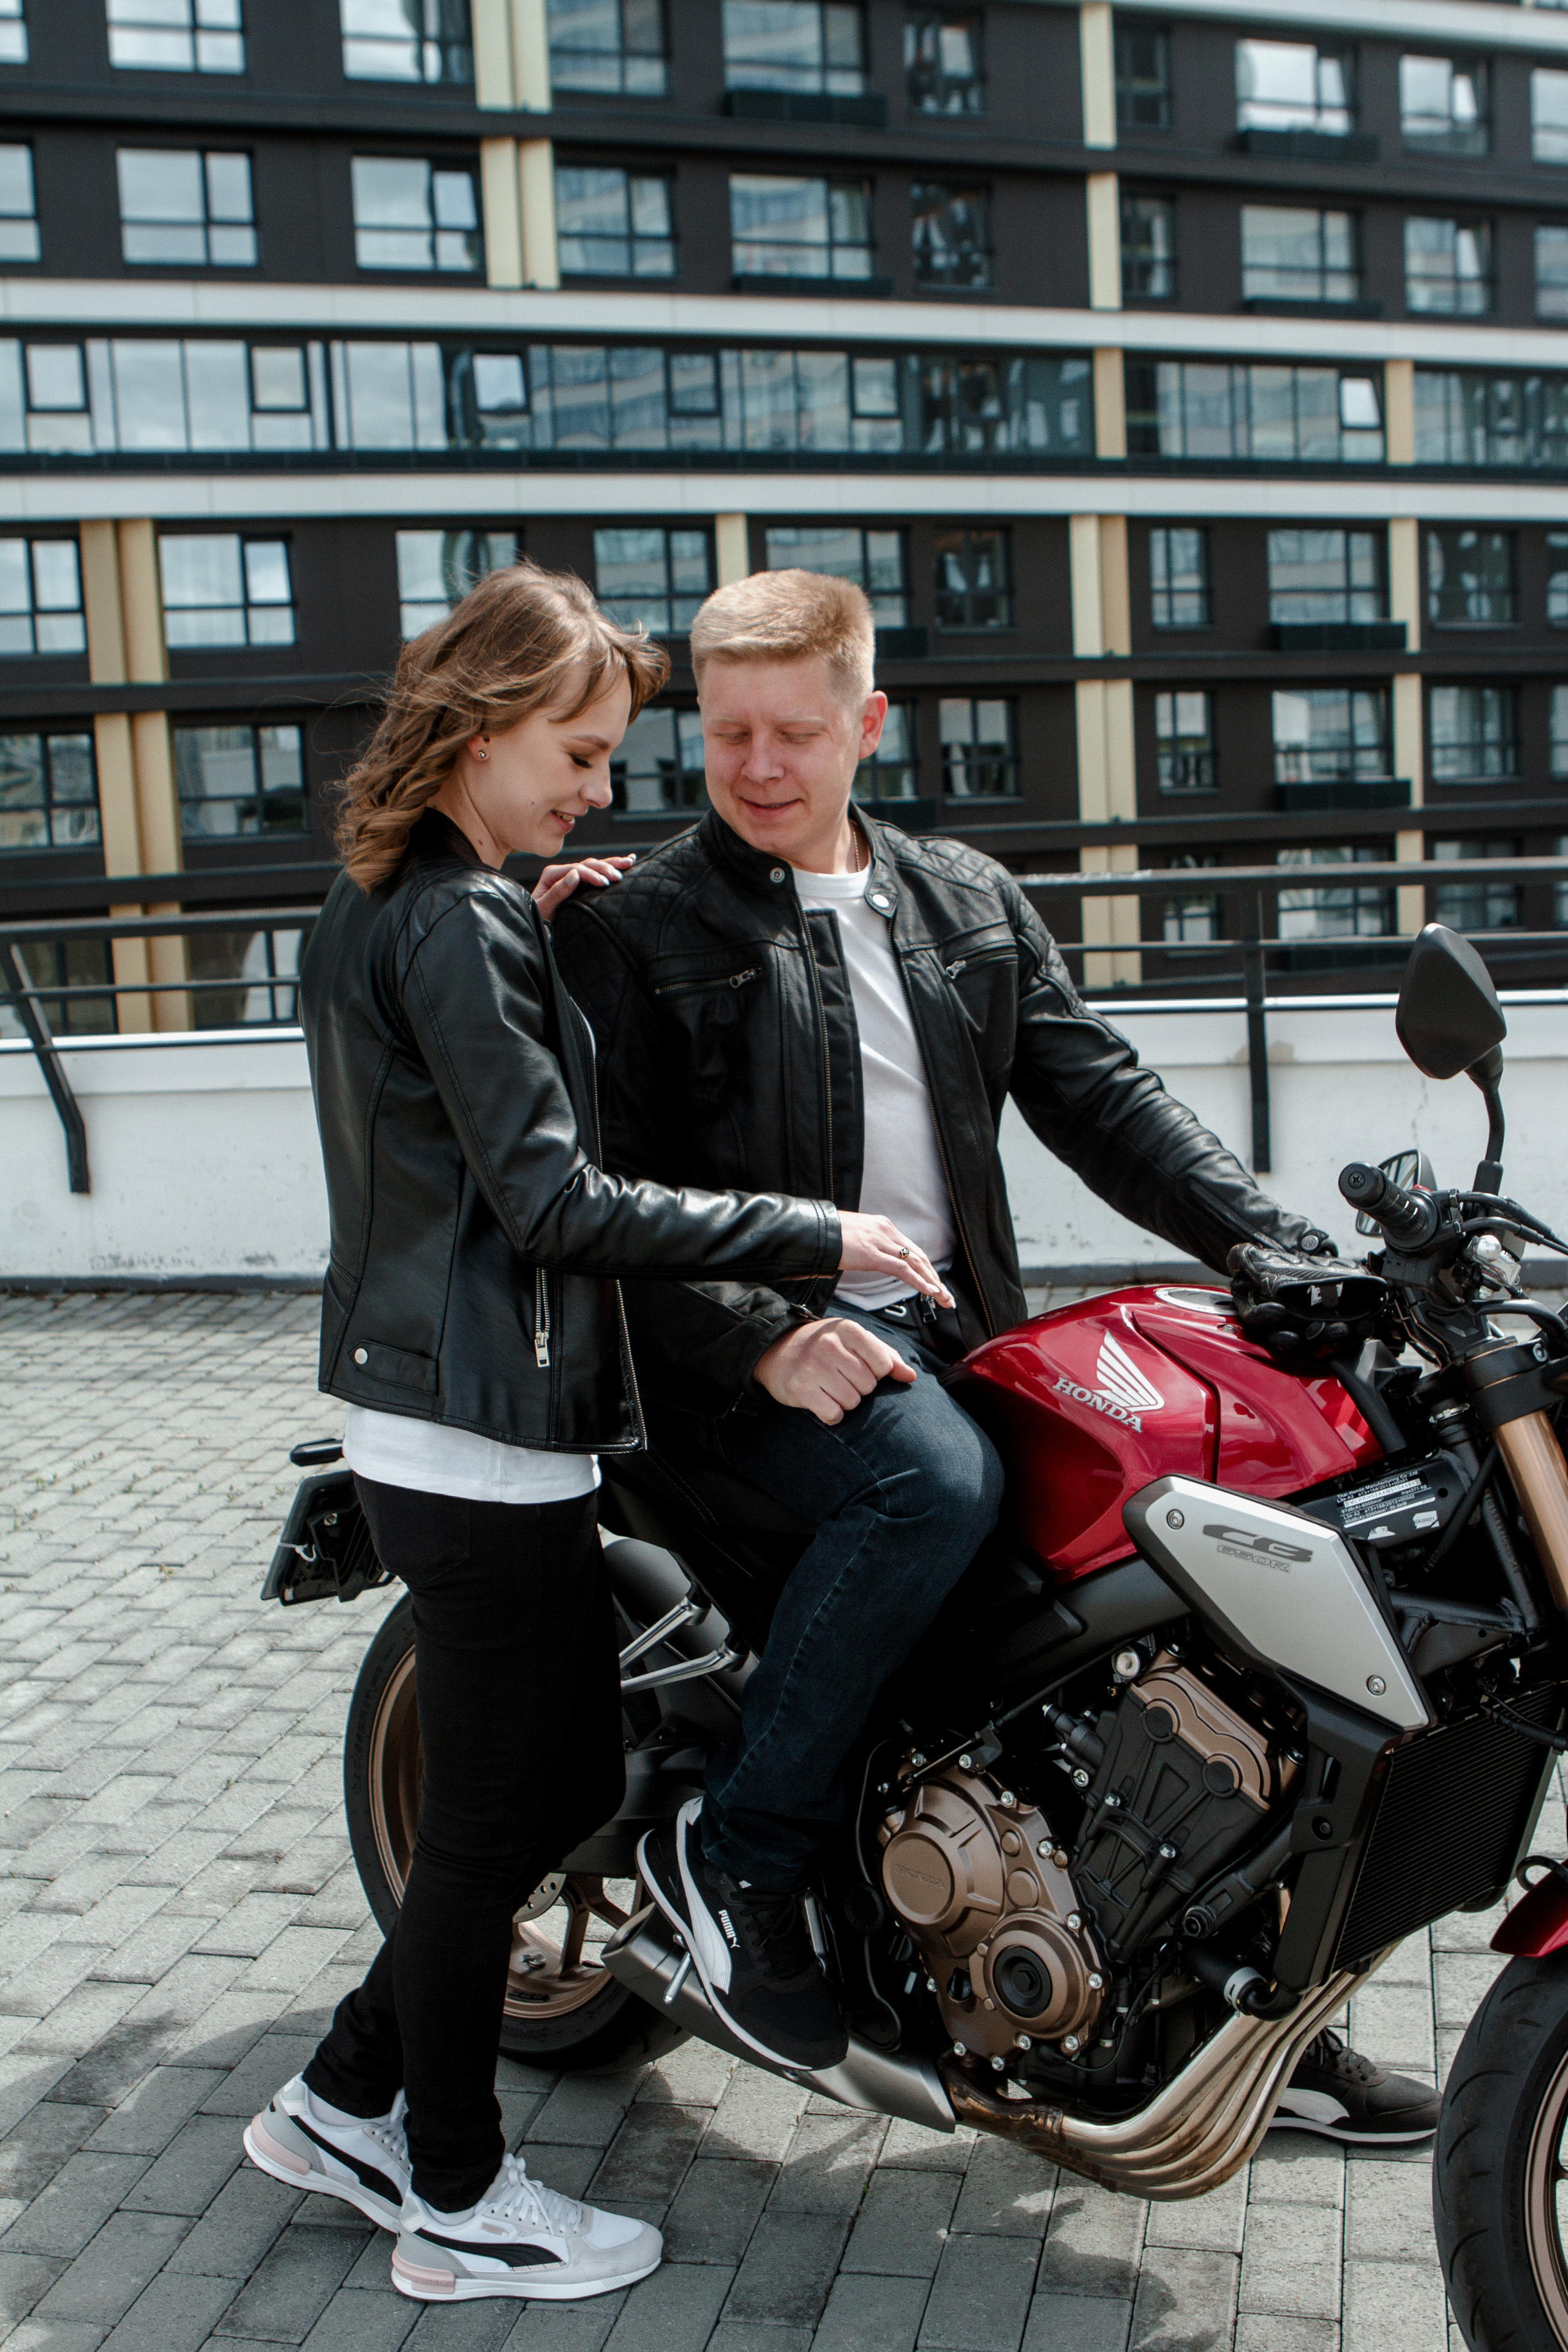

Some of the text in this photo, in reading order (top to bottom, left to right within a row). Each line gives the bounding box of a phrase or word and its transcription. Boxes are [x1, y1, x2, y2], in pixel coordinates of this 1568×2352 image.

[1052, 1377, 1142, 1433] HONDA
[1365, 1476, 1400, 1490] Manufacturing
[1217, 1544, 1289, 1572] 650R
[895, 1863, 945, 1890] HONDA
[718, 1909, 736, 1939] PUMA
